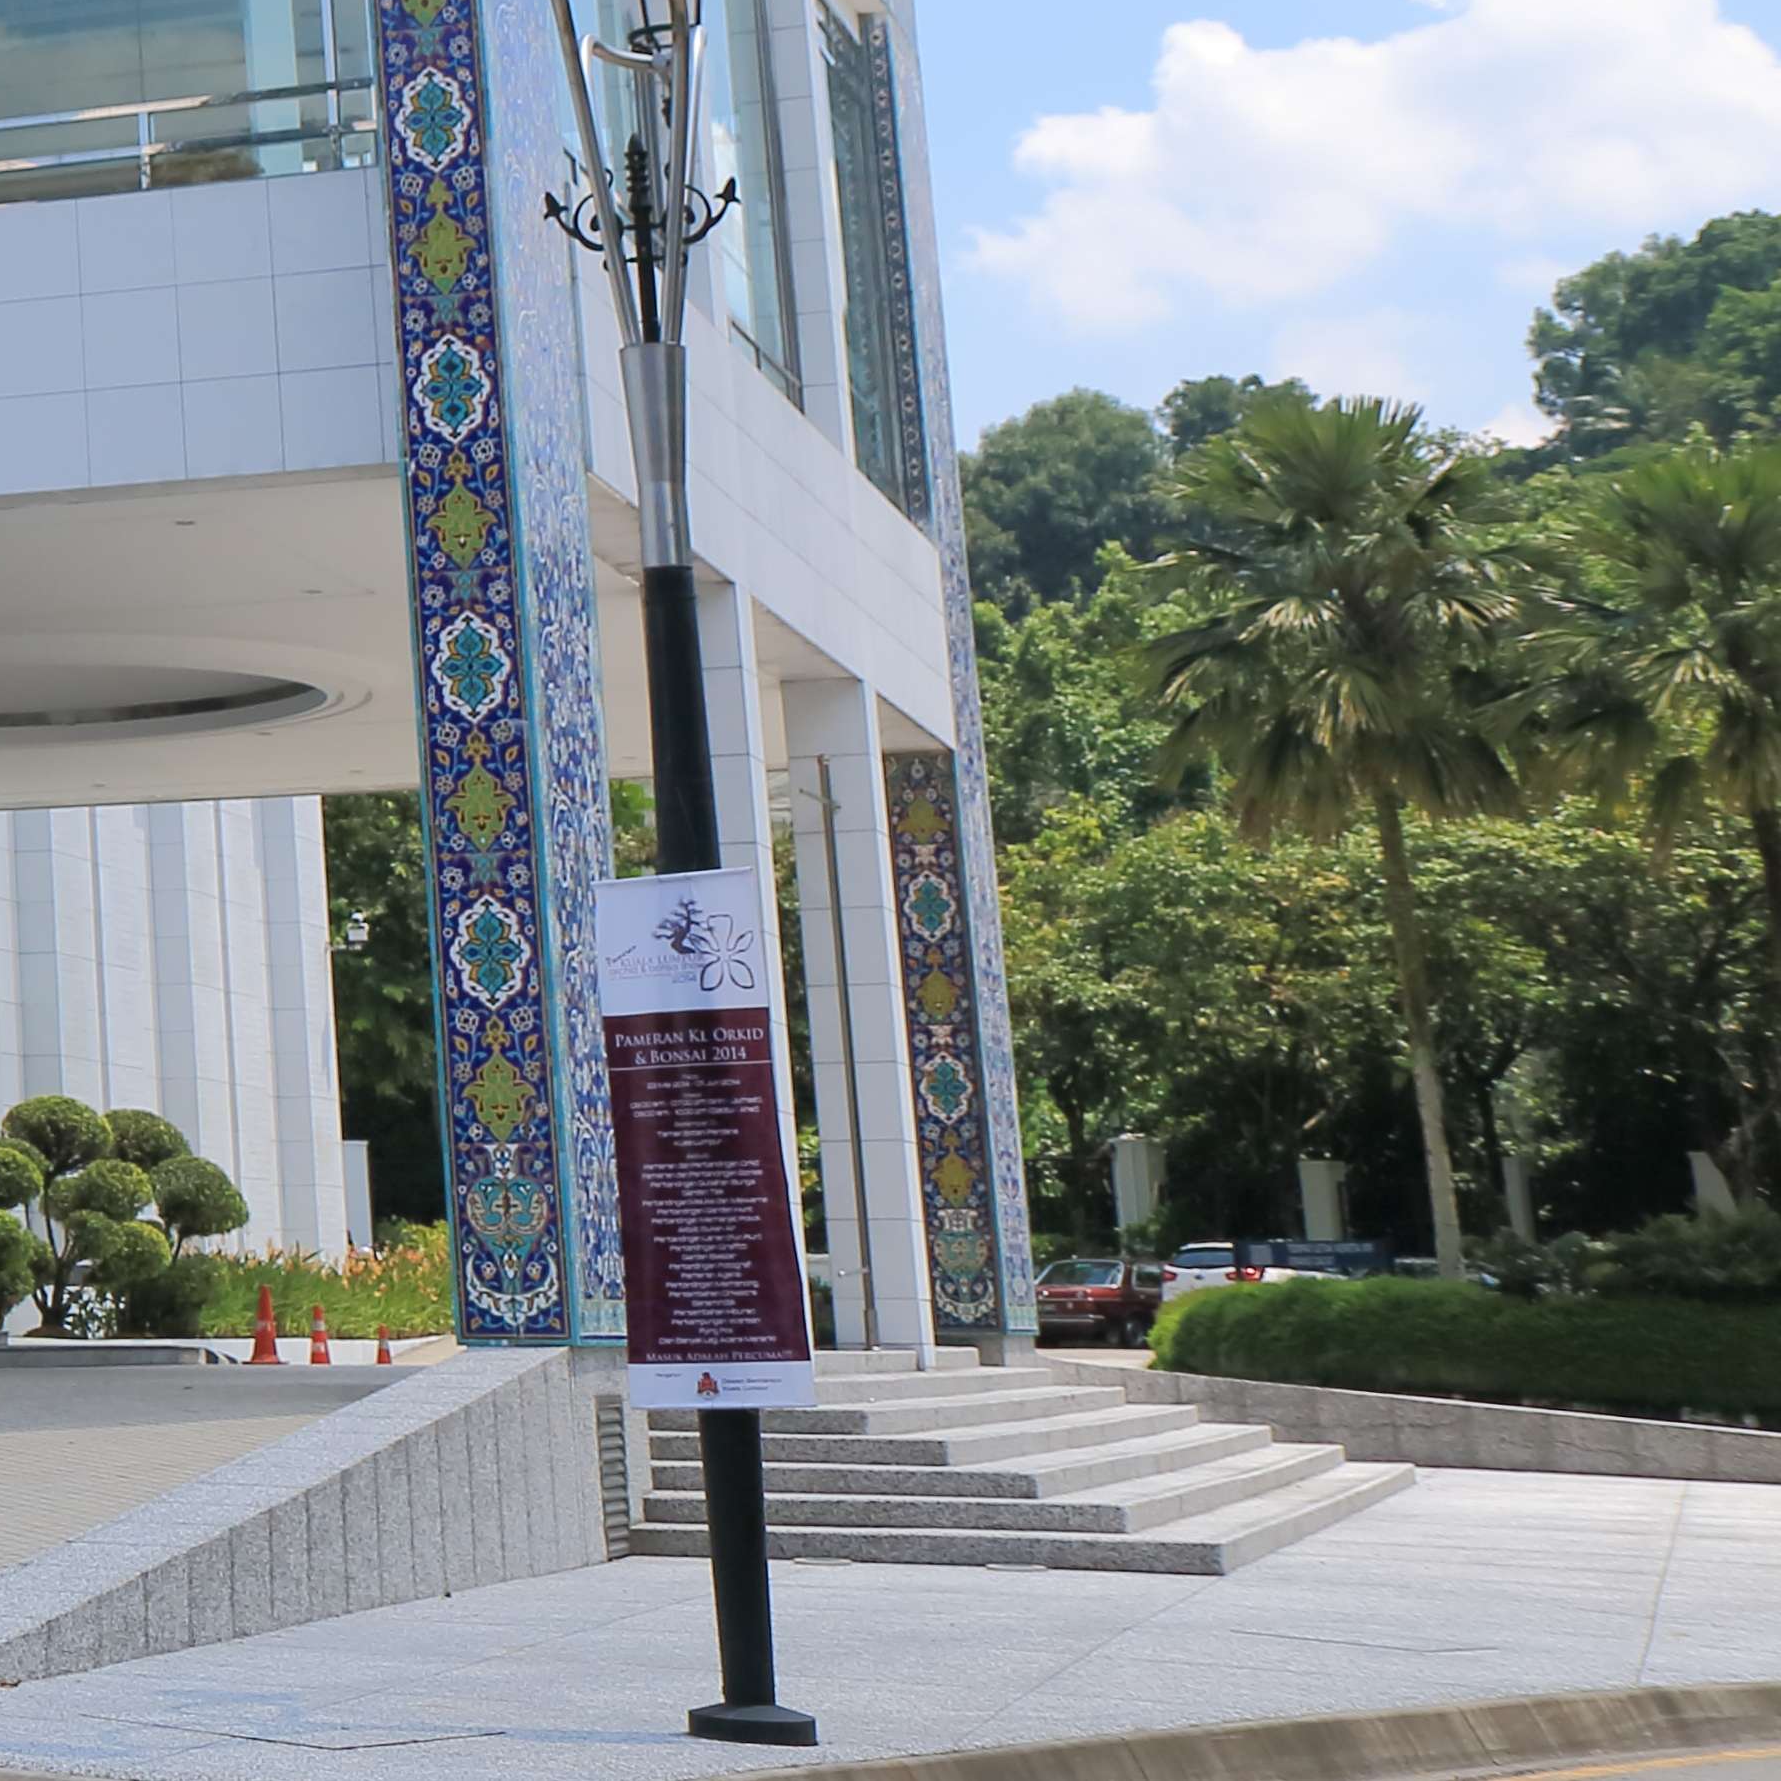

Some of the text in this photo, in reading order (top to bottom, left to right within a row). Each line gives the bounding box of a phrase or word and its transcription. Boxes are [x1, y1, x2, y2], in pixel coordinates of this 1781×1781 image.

[614, 1029, 684, 1048] PAMERAN
[713, 1027, 764, 1042] ORKID
[634, 1046, 747, 1066] & BONSAI 2014
